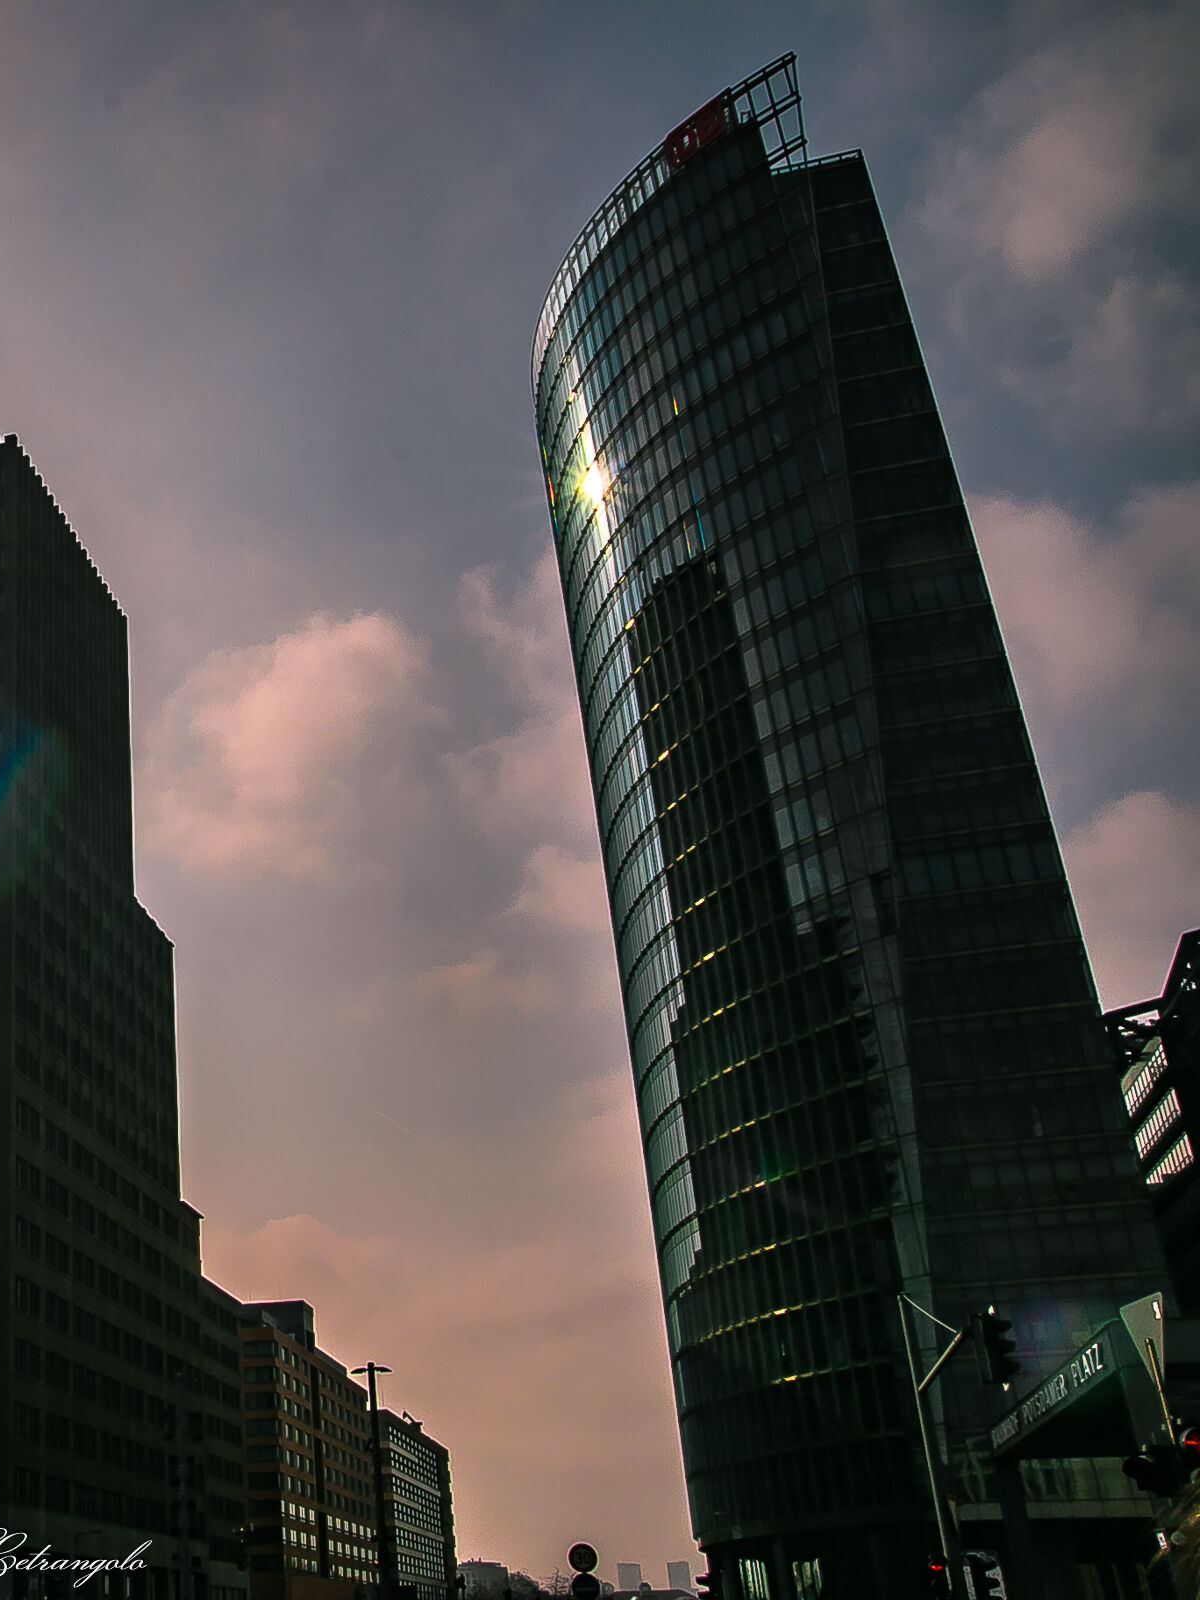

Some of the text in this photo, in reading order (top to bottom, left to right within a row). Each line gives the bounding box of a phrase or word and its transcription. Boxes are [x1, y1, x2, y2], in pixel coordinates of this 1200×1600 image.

[673, 107, 717, 160] DB
[1070, 1343, 1104, 1388] PLATZ
[575, 1550, 591, 1565] 30
